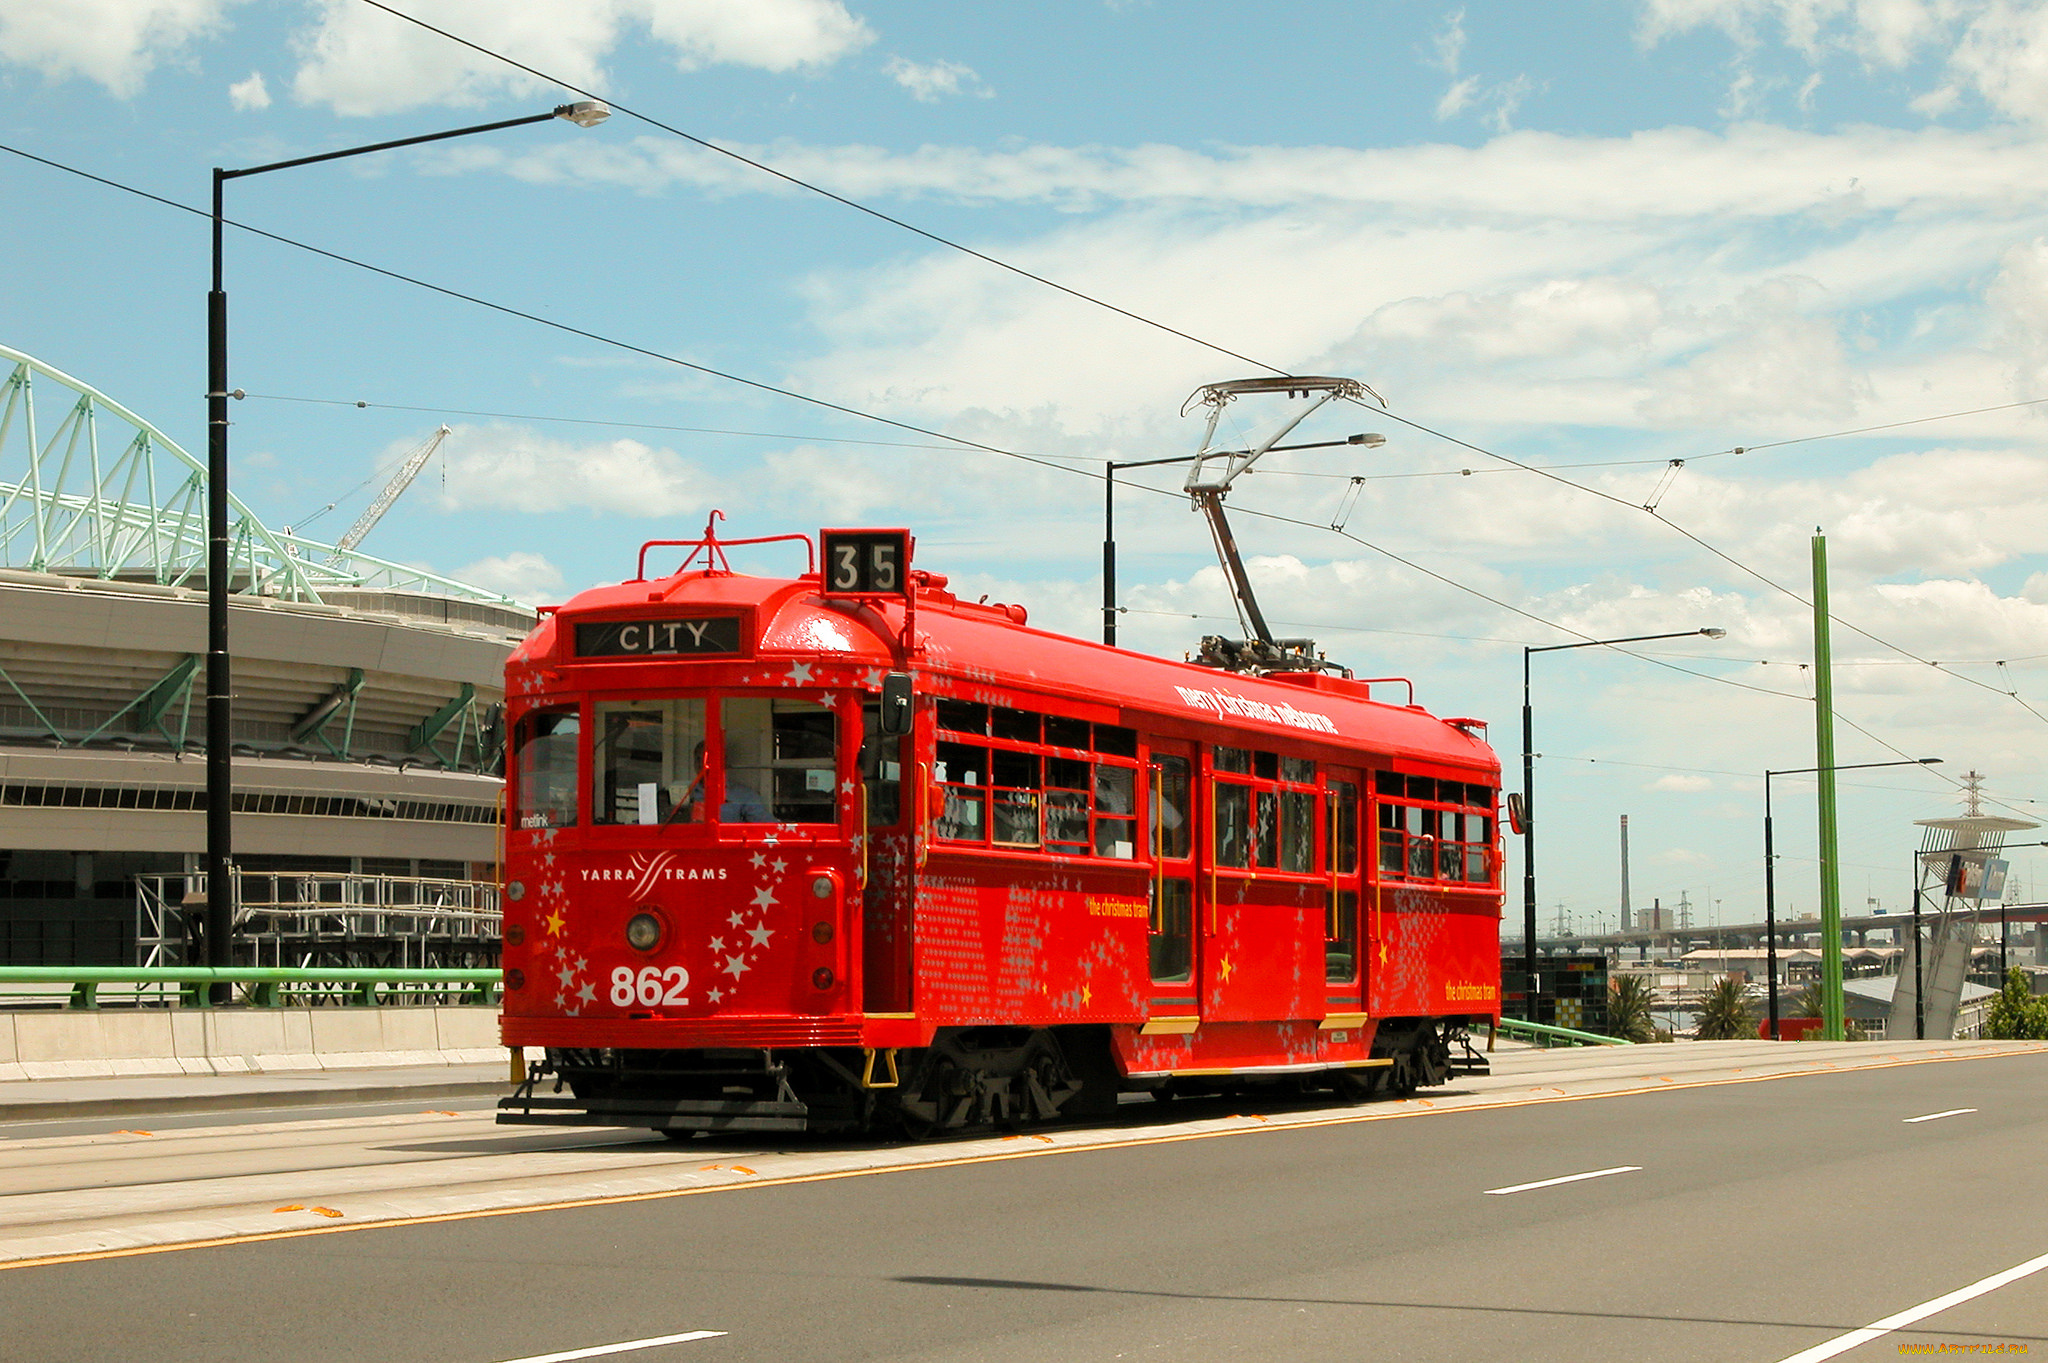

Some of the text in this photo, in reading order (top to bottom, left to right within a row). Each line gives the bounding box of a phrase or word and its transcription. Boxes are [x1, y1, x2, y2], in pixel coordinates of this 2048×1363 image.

[834, 545, 896, 589] 35
[619, 621, 709, 650] CITY
[1174, 685, 1339, 735] merry christmas melbourne
[581, 868, 728, 881] YARRA TRAMS
[1089, 896, 1148, 918] the christmas tram
[610, 966, 689, 1007] 862
[1445, 979, 1496, 1000] the christmas tram
